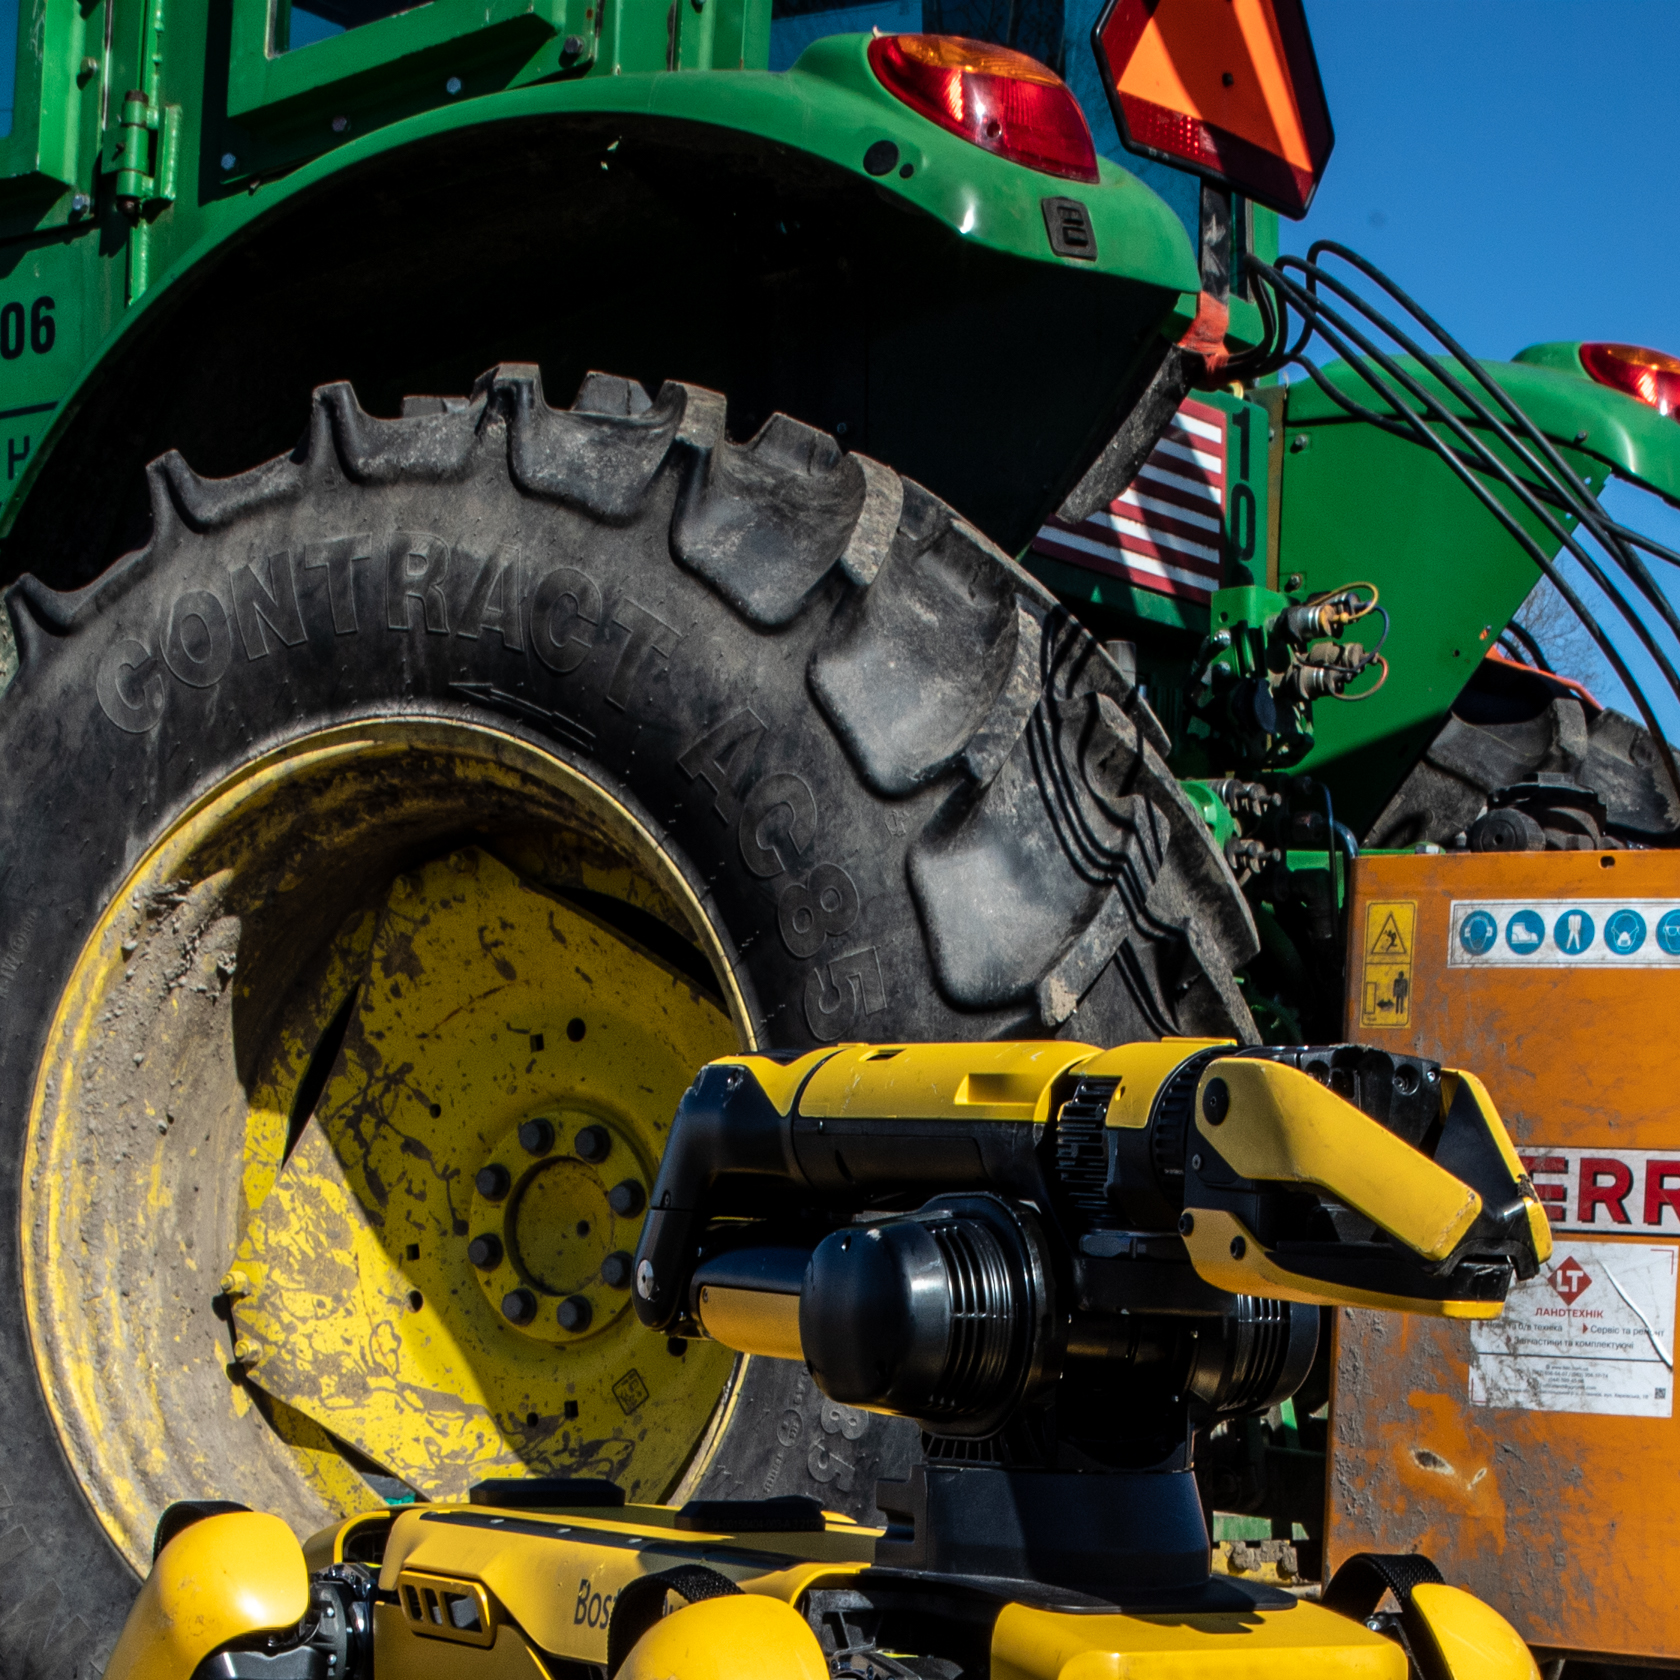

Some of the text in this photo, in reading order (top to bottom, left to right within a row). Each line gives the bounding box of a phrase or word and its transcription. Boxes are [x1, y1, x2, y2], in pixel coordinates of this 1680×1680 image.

[1231, 406, 1257, 586] 10
[95, 528, 682, 735] CONTRACT
[1556, 1269, 1584, 1294] LT
[1590, 1324, 1620, 1336] Сервіс
[1622, 1327, 1631, 1335] та
